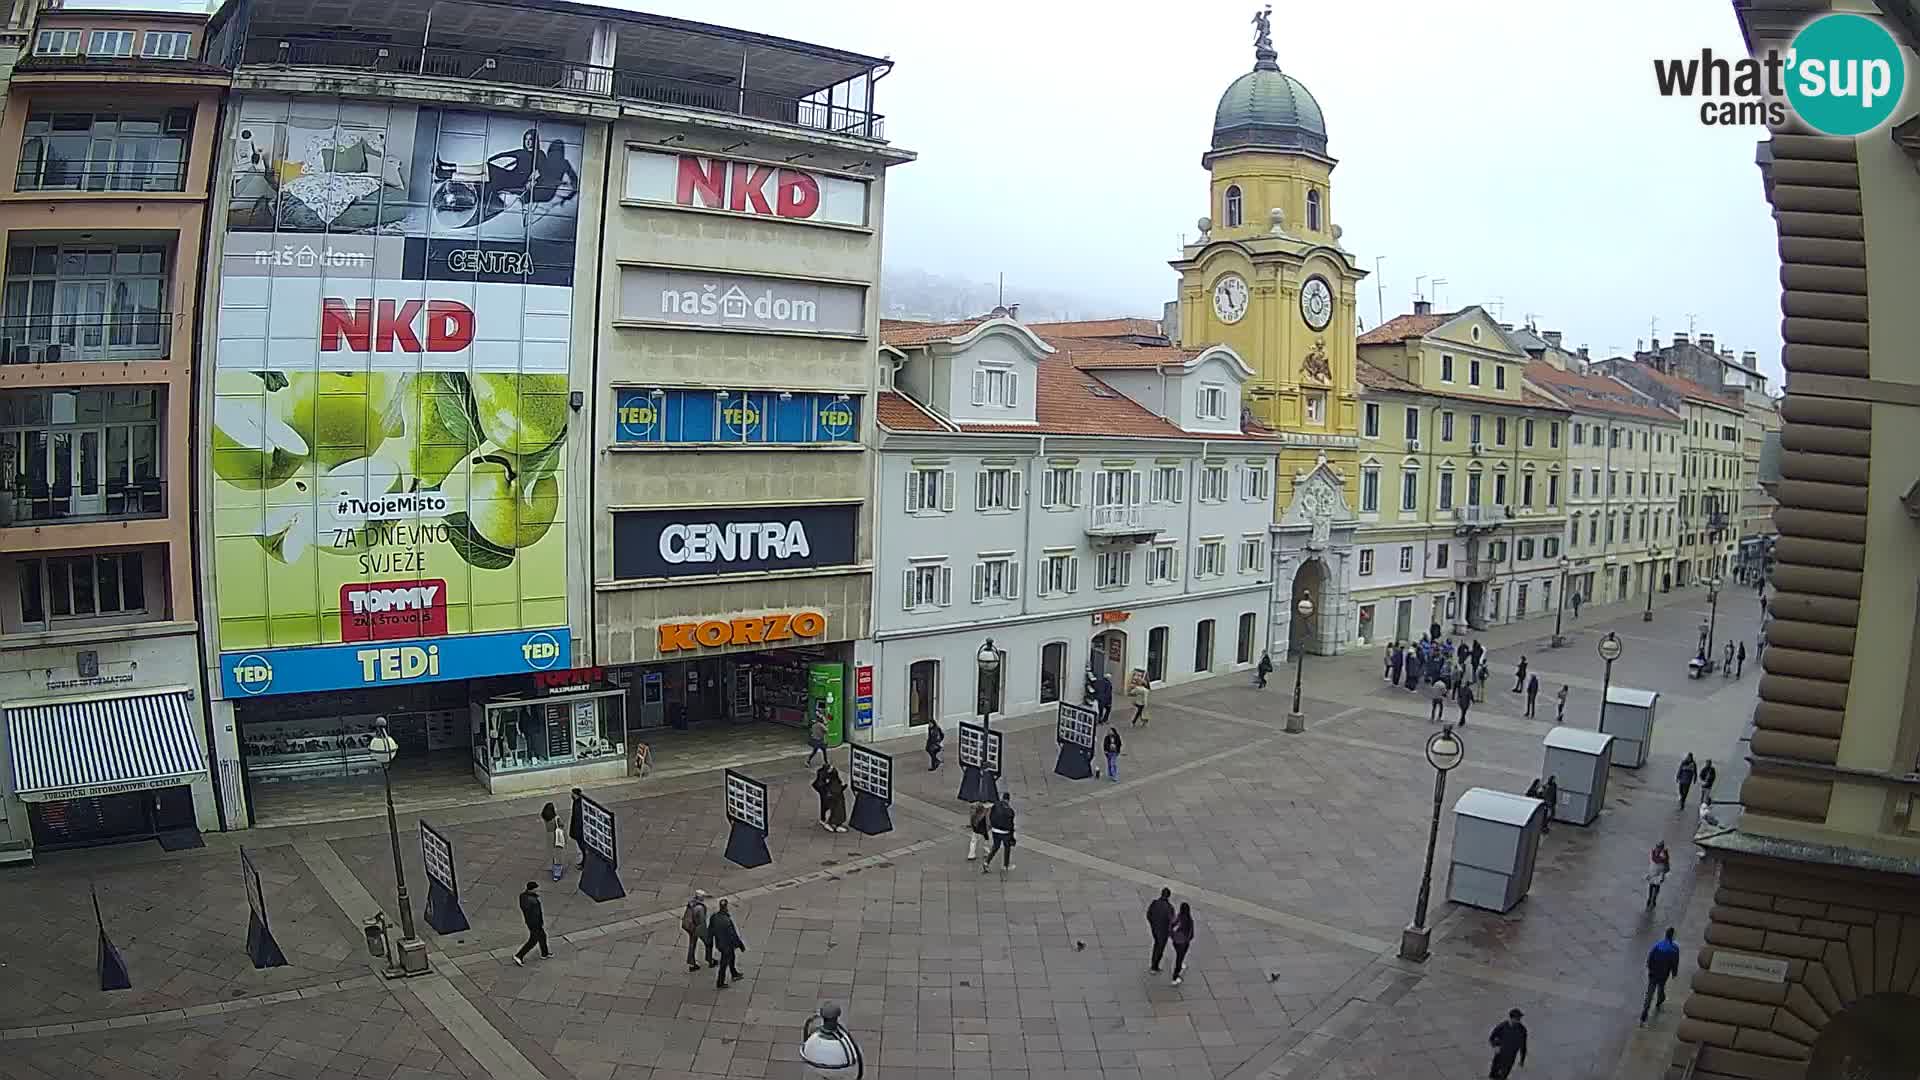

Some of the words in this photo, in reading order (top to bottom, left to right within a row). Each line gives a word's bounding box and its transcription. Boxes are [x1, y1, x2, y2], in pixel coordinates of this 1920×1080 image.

[676, 155, 820, 219] NKD
[255, 246, 294, 266] naš
[319, 247, 365, 267] dom
[448, 249, 534, 275] CENTRA
[661, 284, 717, 316] naš
[754, 290, 817, 322] dom
[320, 298, 475, 352] NKD
[618, 408, 657, 424] TEDi
[723, 408, 760, 425] TEDi
[820, 410, 853, 426] TEDi
[338, 497, 446, 516] #TvojeMisto
[333, 528, 357, 548] ZA
[365, 523, 450, 547] DNEVNO
[659, 520, 810, 564] CENTRA
[359, 547, 425, 574] SVJEŽE
[348, 586, 438, 614] TOMMY
[402, 612, 432, 623] VOŠ
[659, 612, 827, 652] KORZO
[357, 645, 439, 682] TEDi
[522, 643, 560, 659] TEDi
[233, 665, 273, 683] TEDi
[150, 778, 182, 788] CENTAR
